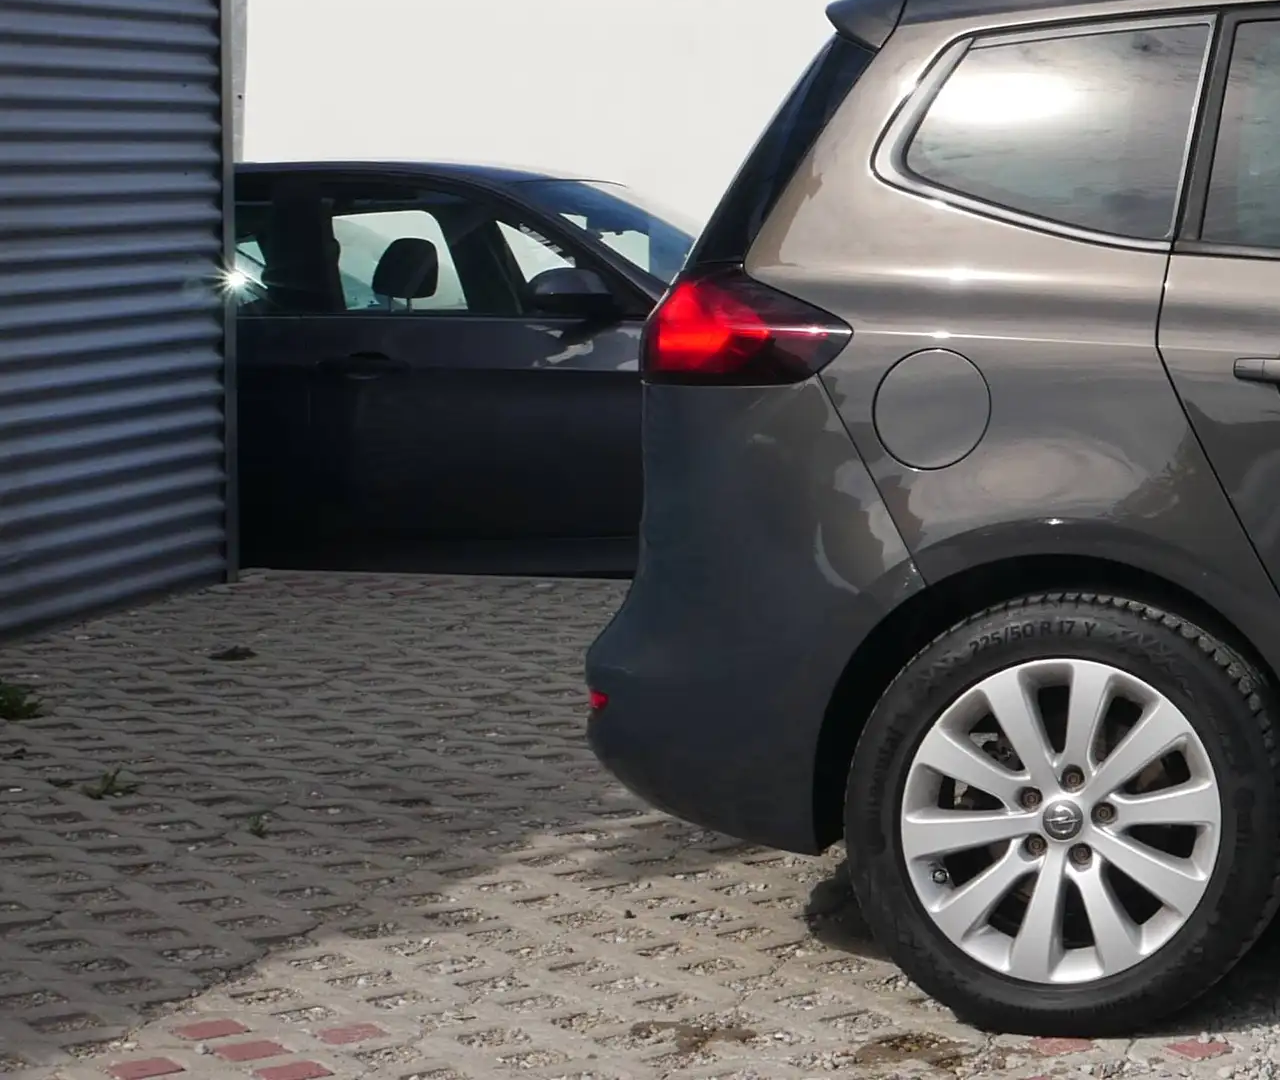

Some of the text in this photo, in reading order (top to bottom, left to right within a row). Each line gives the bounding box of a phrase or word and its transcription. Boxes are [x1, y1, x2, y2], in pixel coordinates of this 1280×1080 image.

[969, 622, 1034, 656] 225/50
[1040, 622, 1054, 635] R
[1058, 621, 1074, 635] 17
